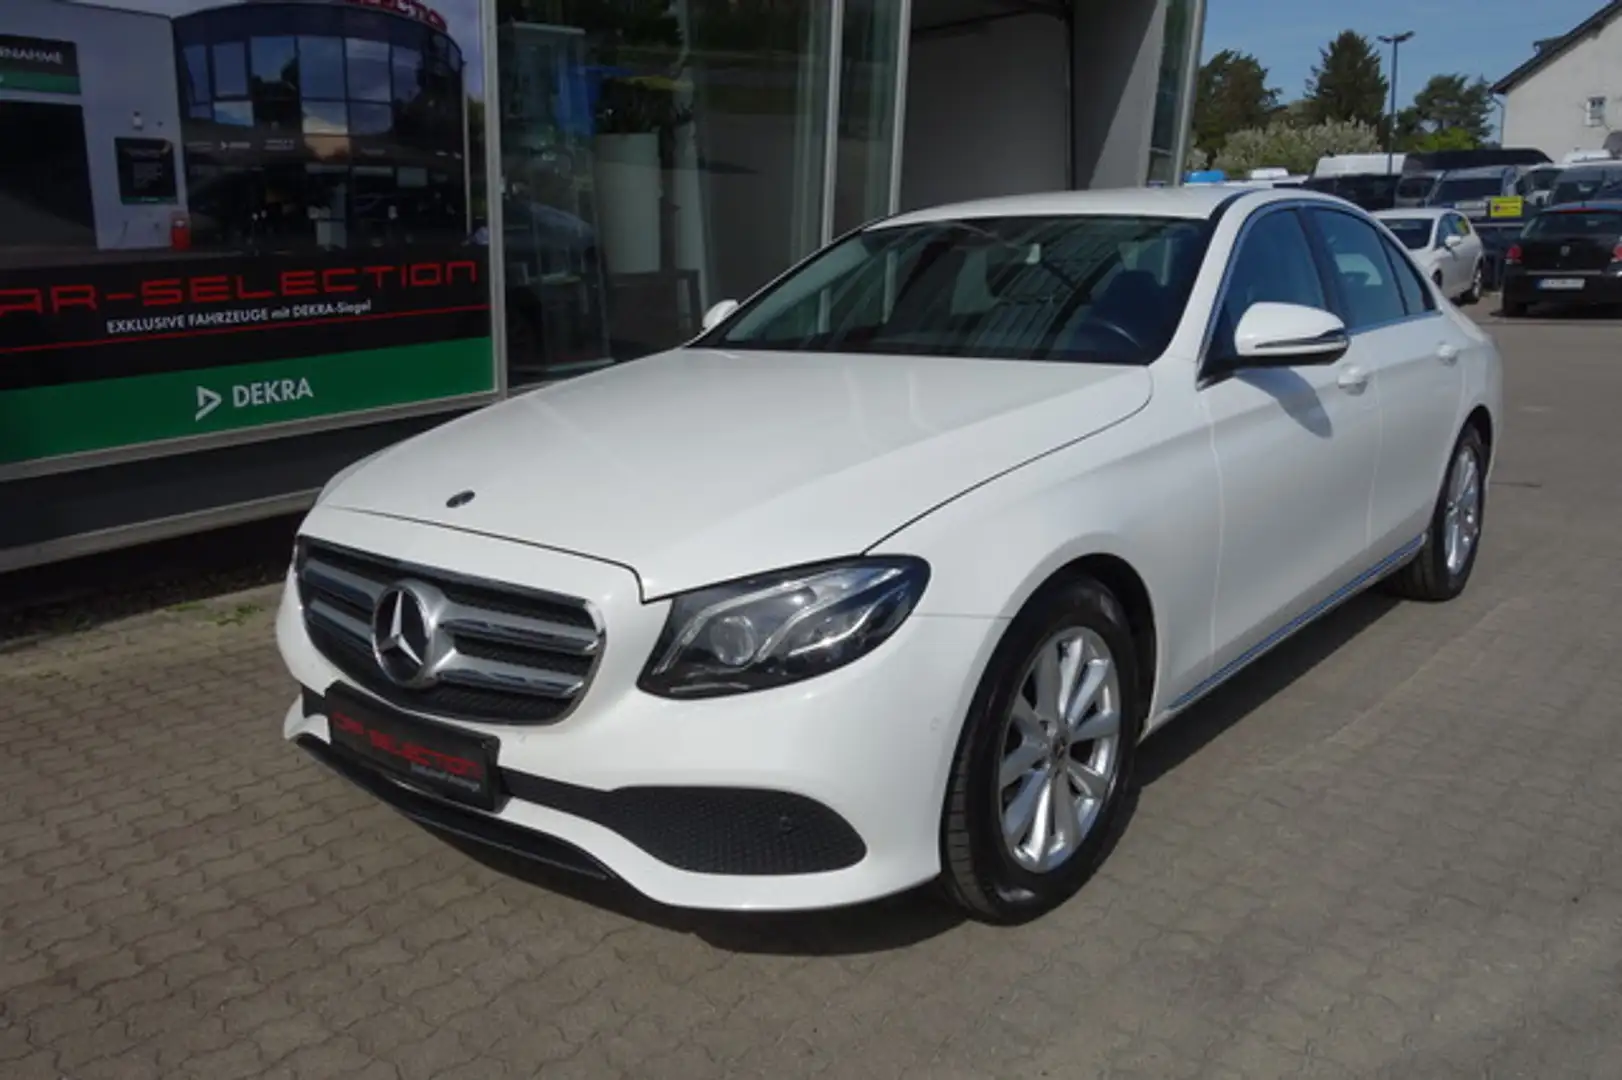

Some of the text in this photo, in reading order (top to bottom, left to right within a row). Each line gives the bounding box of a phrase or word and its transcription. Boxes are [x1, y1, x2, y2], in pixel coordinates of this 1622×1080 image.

[106, 298, 371, 334] EXKLUSIVE FAHRZEUGE mit DEKRA-Siegel
[232, 377, 314, 408] DEKRA
